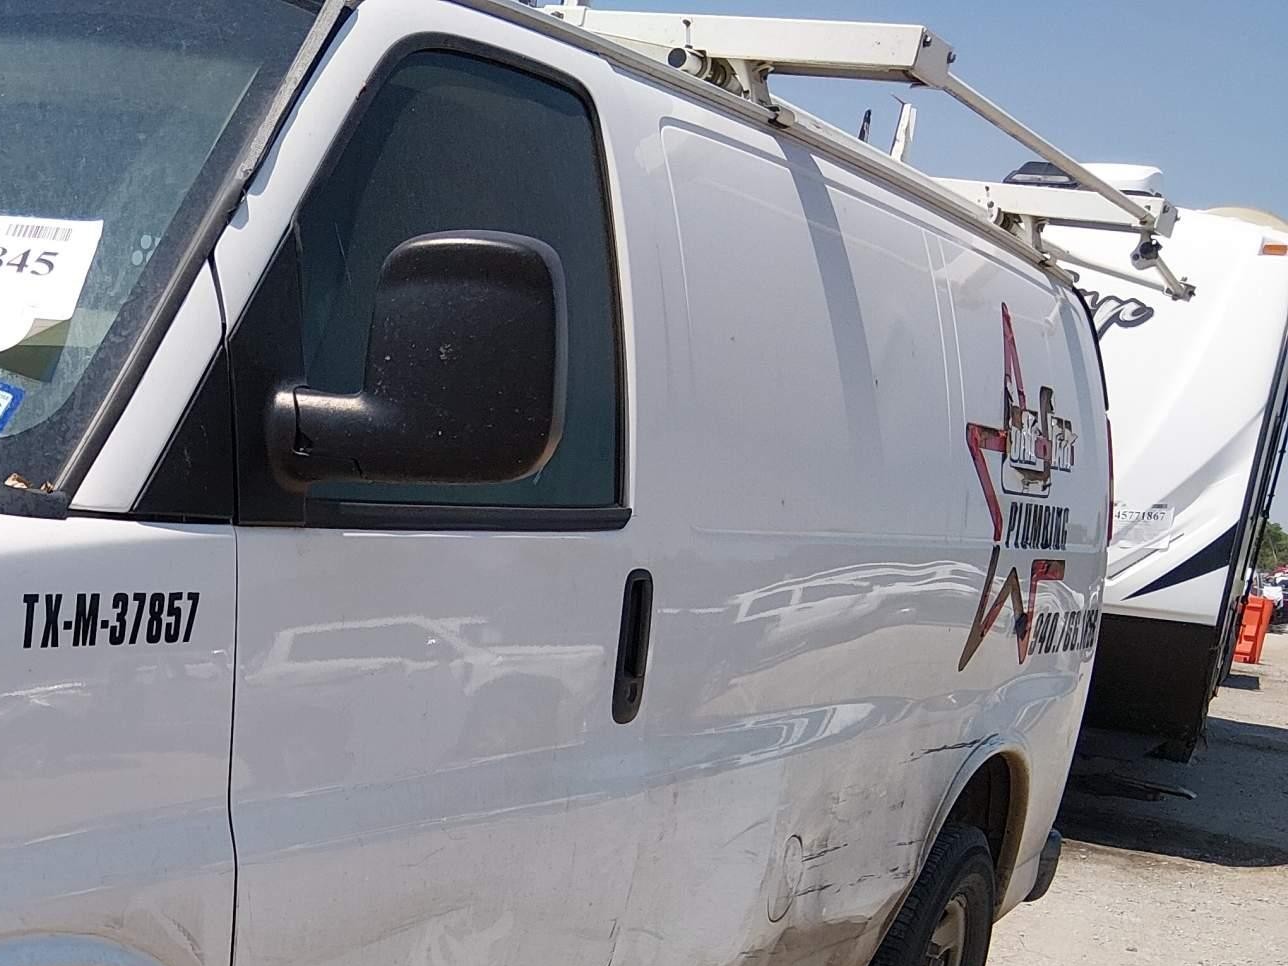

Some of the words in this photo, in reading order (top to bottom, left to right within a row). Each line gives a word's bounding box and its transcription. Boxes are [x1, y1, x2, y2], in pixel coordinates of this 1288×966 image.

[1004, 501, 1070, 551] PLUMBING
[1114, 510, 1167, 521] 45771867
[22, 591, 201, 649] TX-M-37857
